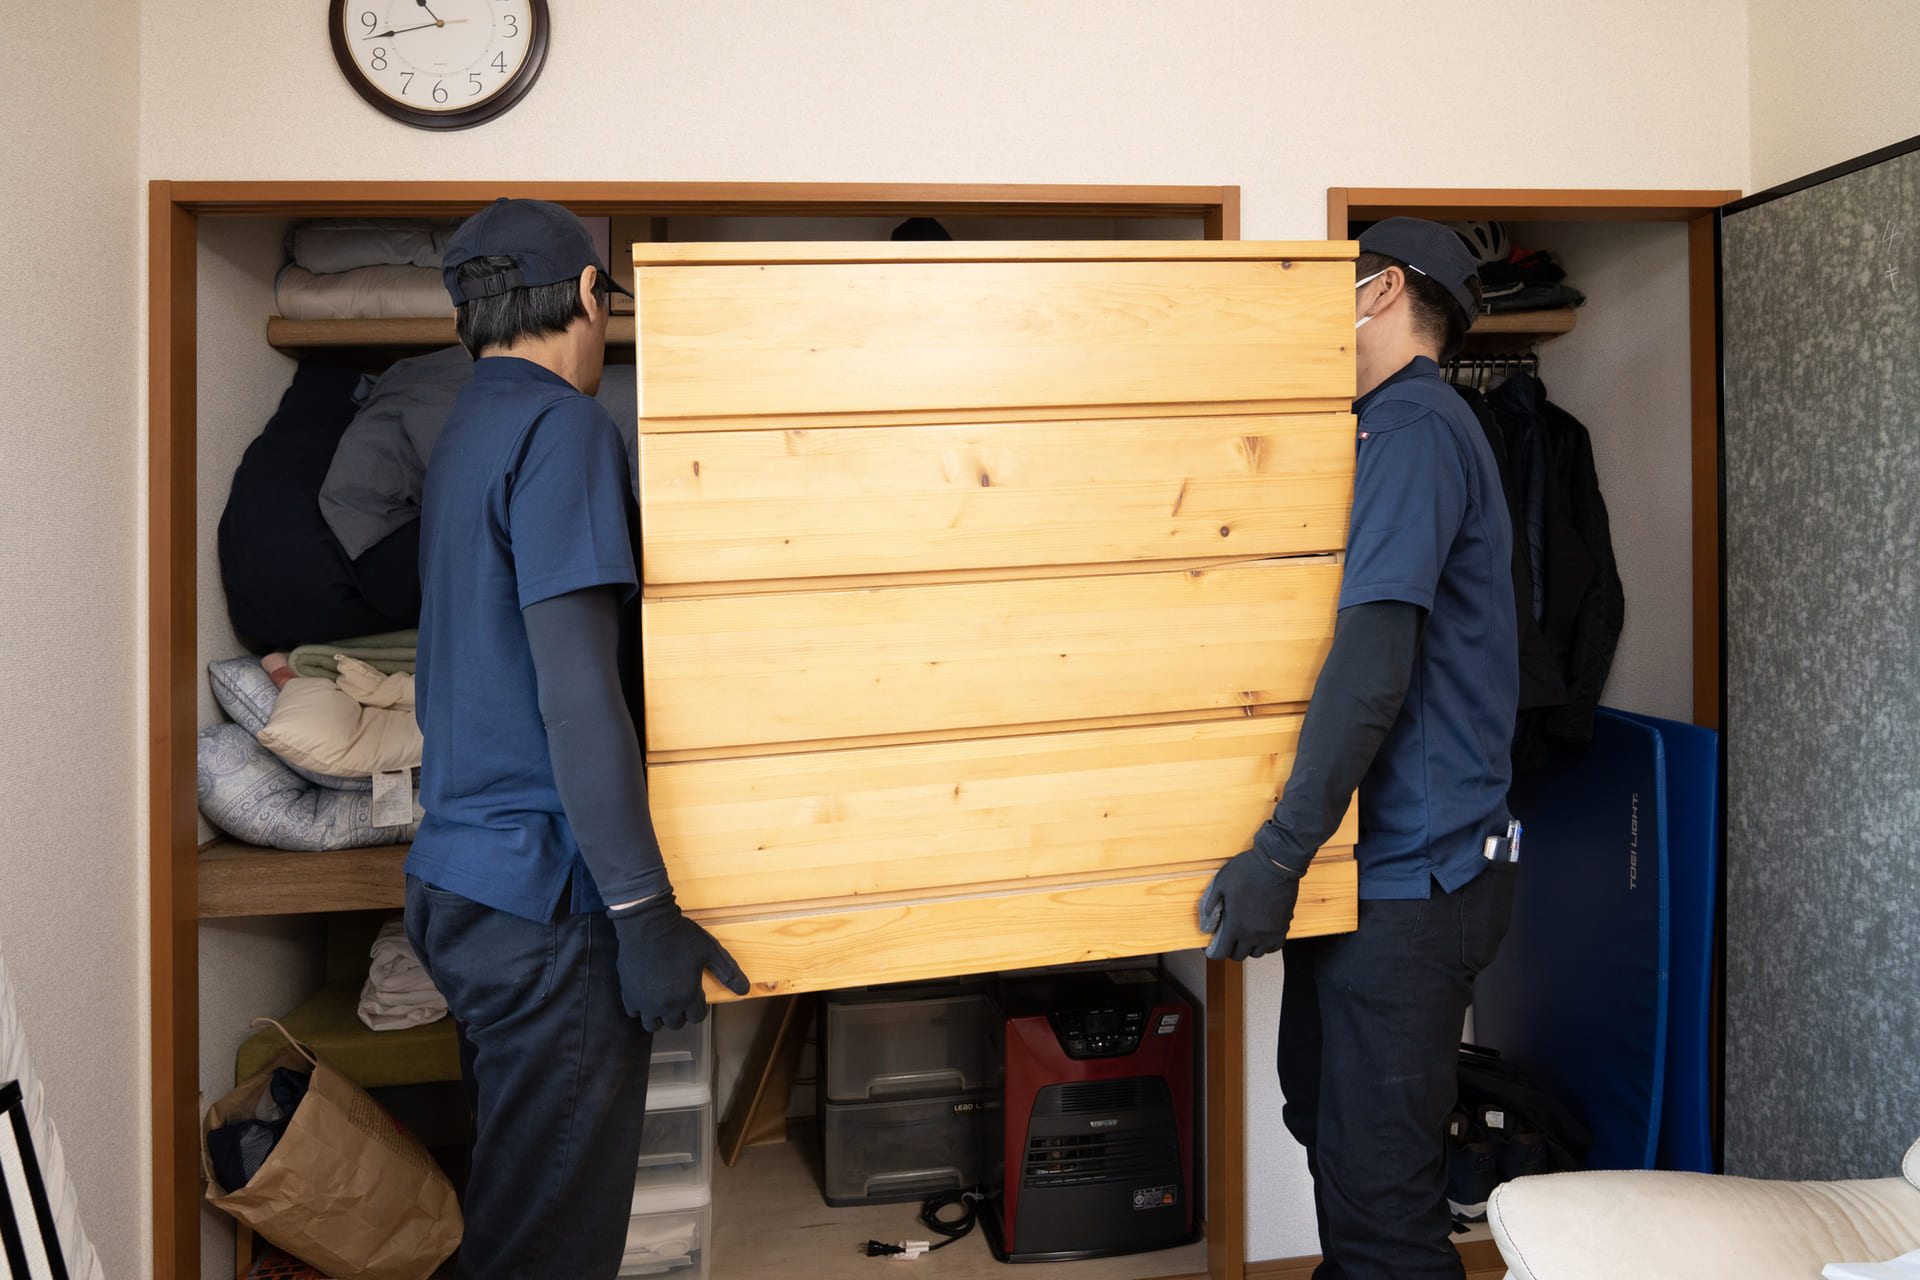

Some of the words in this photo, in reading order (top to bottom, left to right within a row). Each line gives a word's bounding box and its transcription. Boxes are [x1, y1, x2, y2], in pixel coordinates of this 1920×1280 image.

[361, 11, 377, 36] 9
[503, 14, 518, 39] 3
[371, 47, 388, 71] 8
[490, 51, 508, 74] 4
[400, 72, 415, 95] 7
[432, 80, 448, 104] 6
[468, 72, 482, 97] 5
[1629, 850, 1637, 890] TOEI
